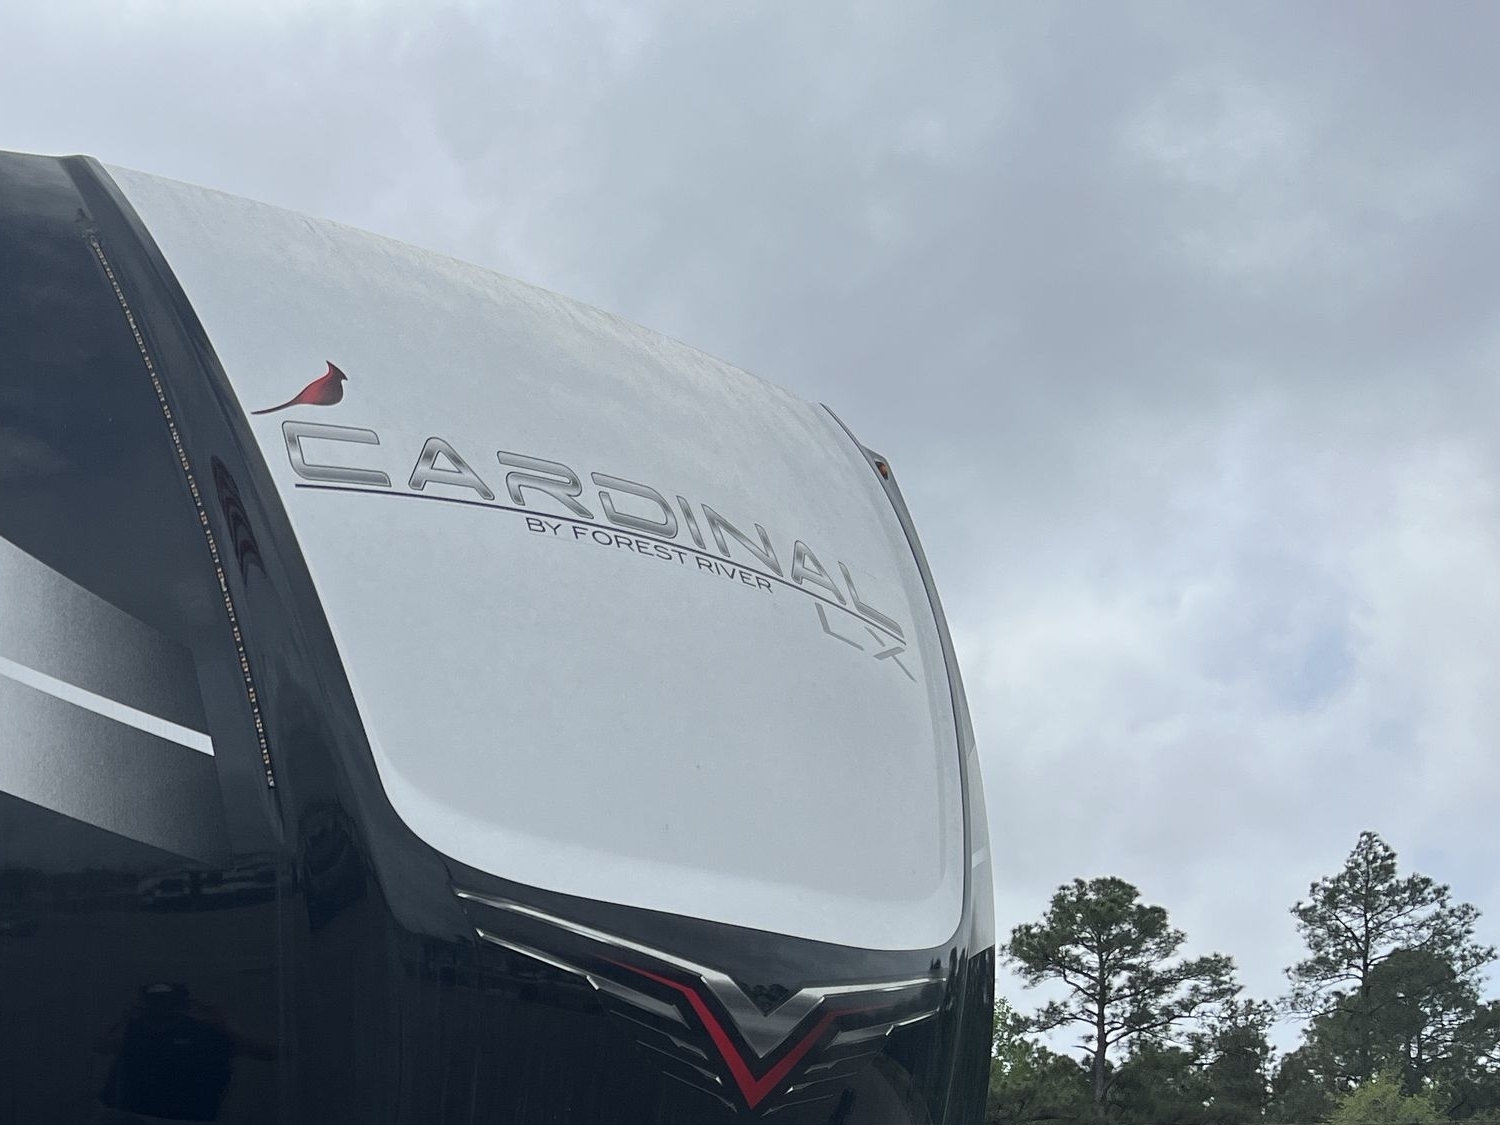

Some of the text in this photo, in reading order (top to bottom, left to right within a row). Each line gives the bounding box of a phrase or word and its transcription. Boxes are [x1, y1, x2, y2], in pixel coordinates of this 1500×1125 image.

[282, 420, 905, 640] CARDINAL
[525, 516, 774, 594] BY FOREST RIVER
[814, 601, 917, 683] LX
